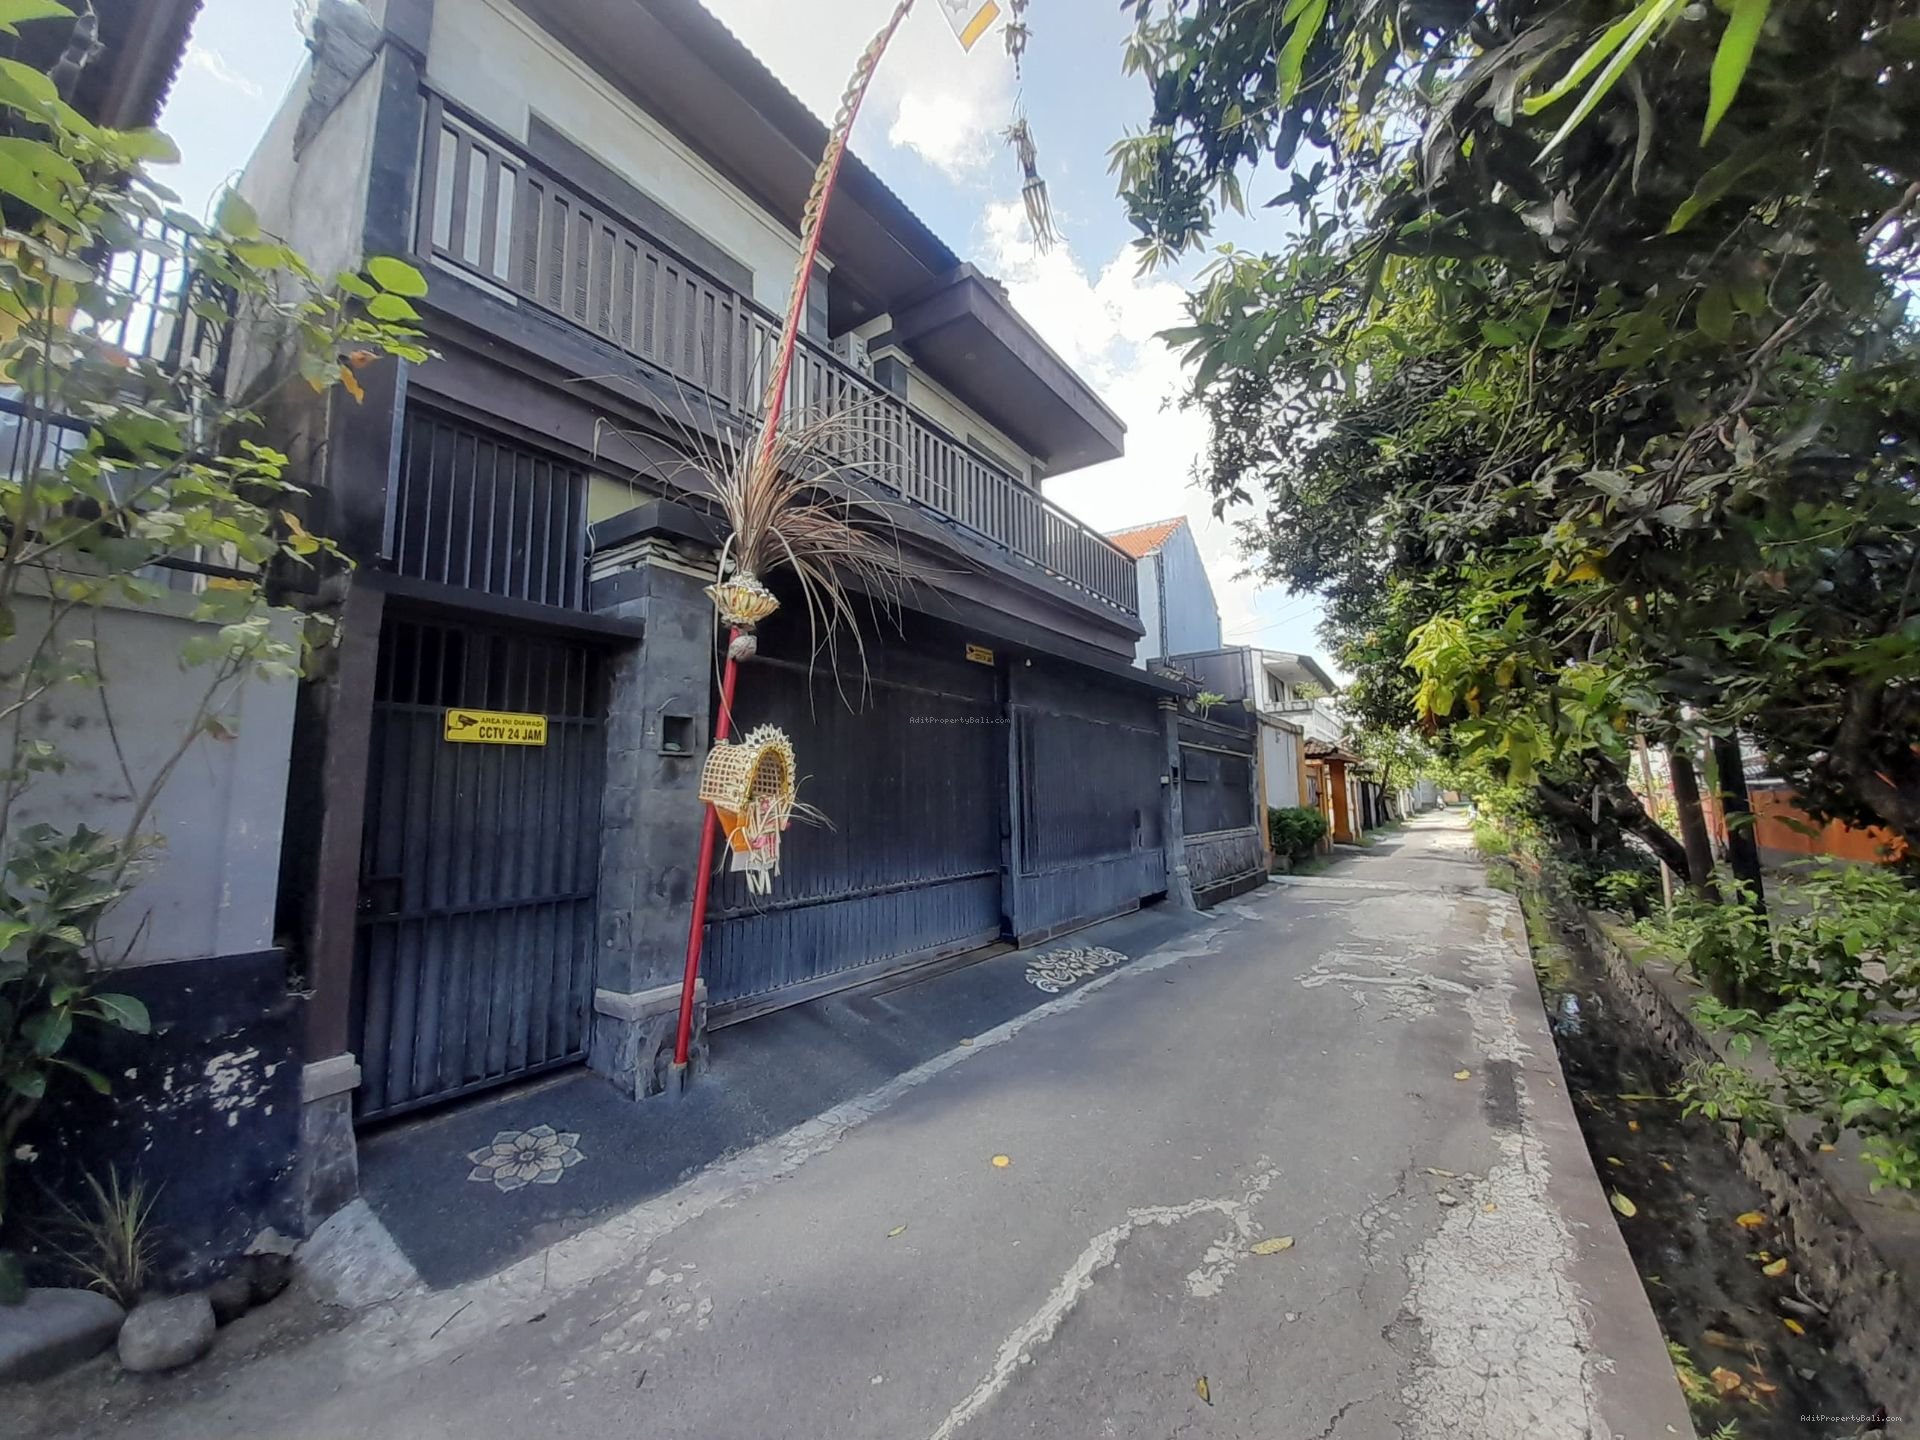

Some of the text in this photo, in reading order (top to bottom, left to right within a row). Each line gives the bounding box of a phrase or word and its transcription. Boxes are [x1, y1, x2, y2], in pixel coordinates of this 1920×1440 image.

[479, 726, 542, 741] CCTV 24 JAM
